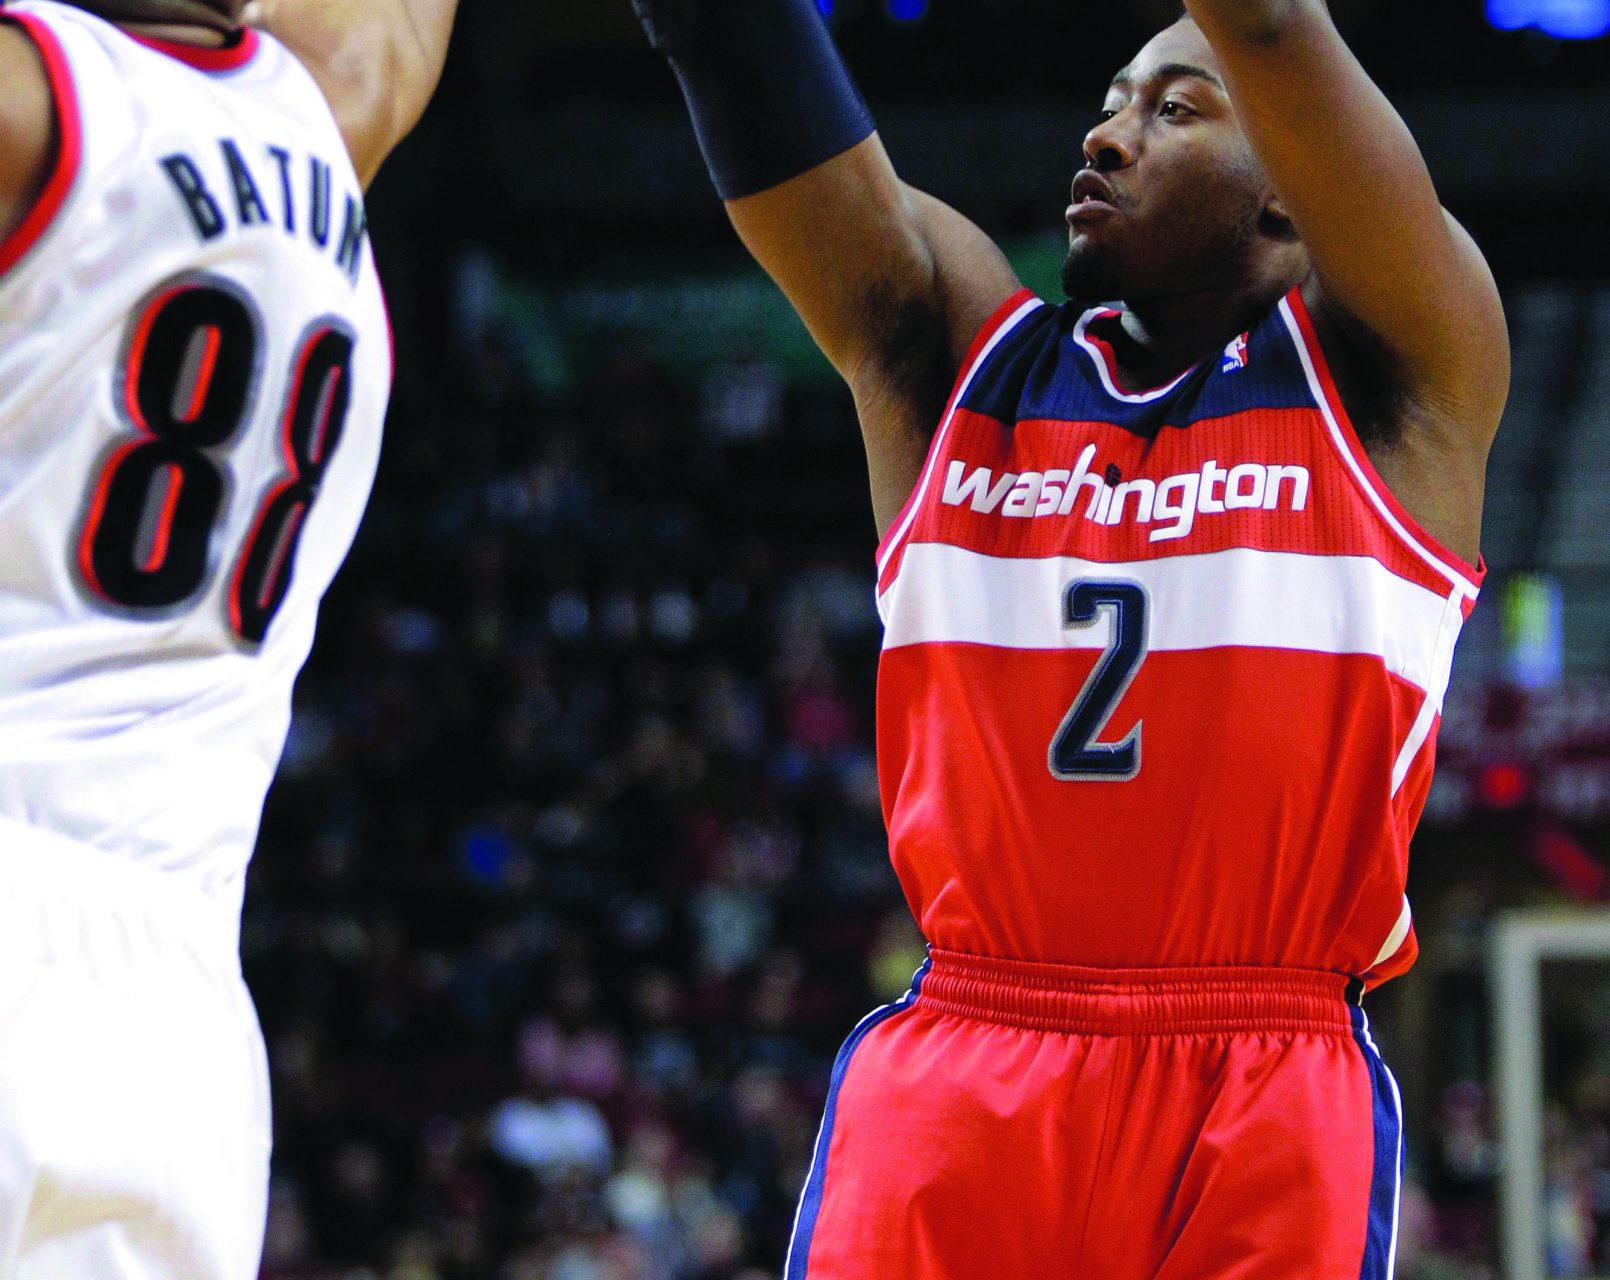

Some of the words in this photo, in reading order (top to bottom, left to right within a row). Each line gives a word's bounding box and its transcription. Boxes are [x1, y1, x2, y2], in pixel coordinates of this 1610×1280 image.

[1223, 359, 1240, 373] NBA
[66, 267, 358, 658] 88
[941, 443, 1310, 543] washington
[1047, 577, 1150, 781] 2
